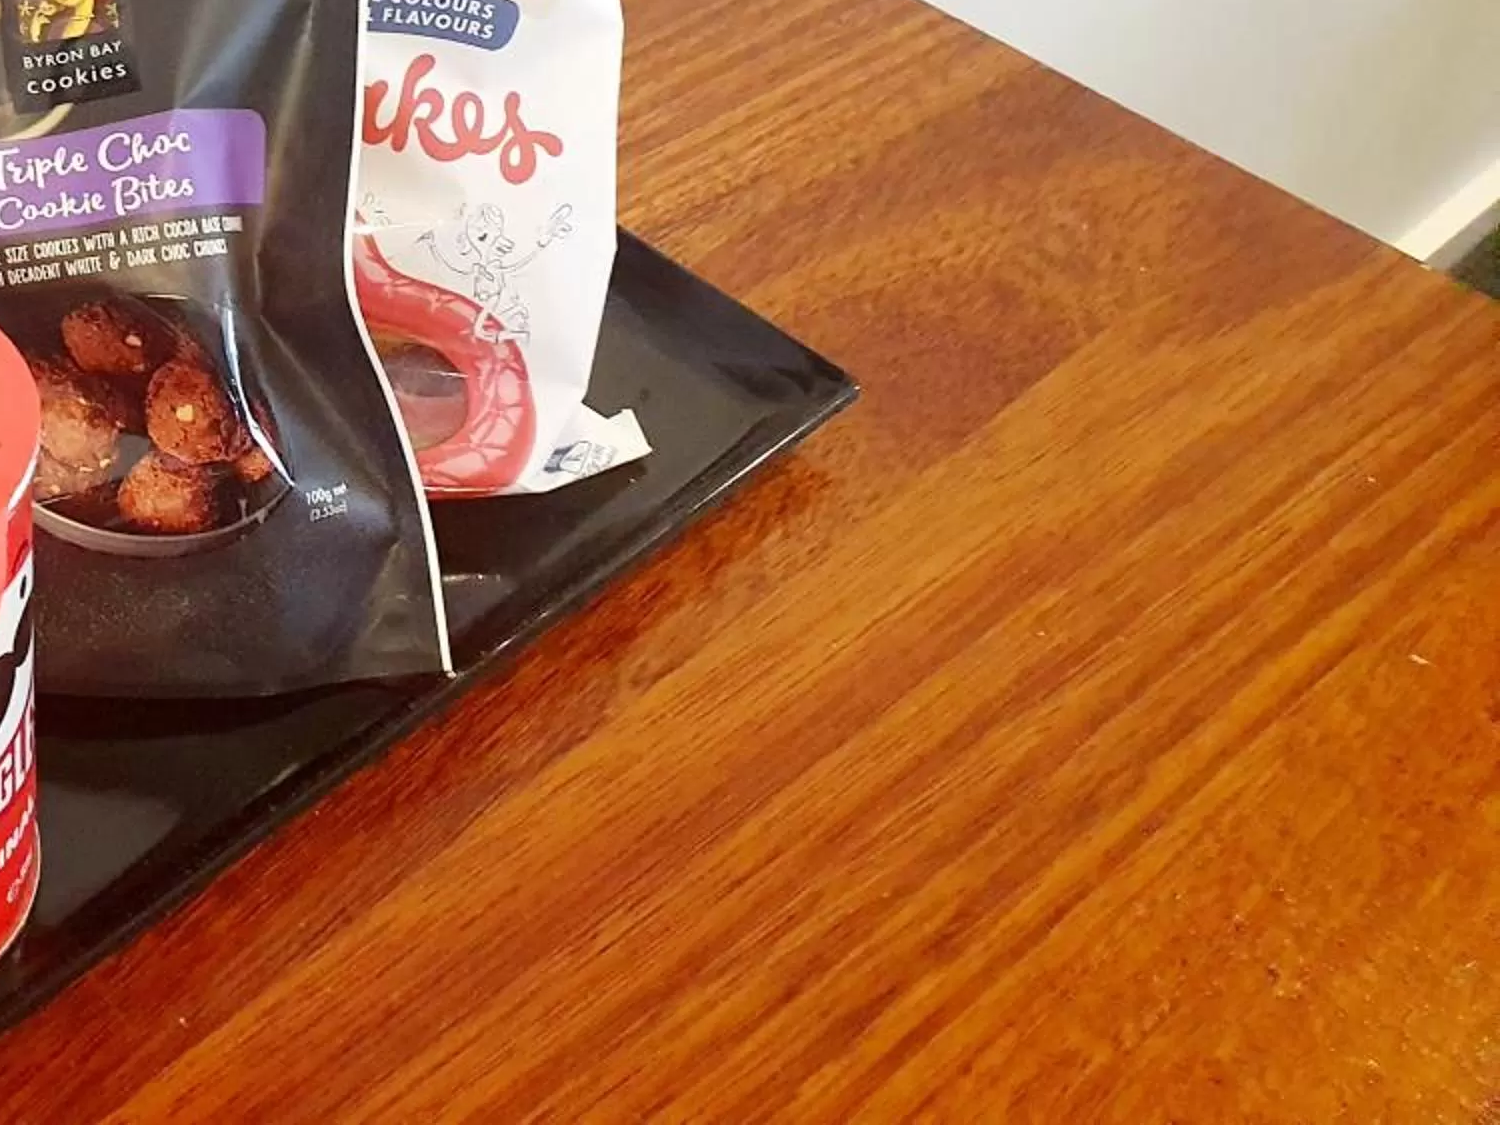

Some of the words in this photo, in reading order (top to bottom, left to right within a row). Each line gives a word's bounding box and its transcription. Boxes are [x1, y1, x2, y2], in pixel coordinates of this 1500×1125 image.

[383, 8, 494, 40] FLAVOURS
[22, 48, 84, 70] BYRON
[88, 40, 121, 58] BAY
[26, 63, 127, 94] cookies
[97, 132, 192, 172] Choc
[111, 174, 195, 216] Bites
[4, 245, 30, 264] SIZE
[33, 238, 80, 260] COOKIES
[83, 232, 115, 252] WITH
[119, 229, 128, 246] A
[131, 225, 161, 244] RICH
[163, 219, 199, 238] COCOA
[7, 262, 61, 286] DECADENT
[64, 255, 102, 277] WHITE
[108, 251, 121, 270] &
[126, 247, 157, 267] DARK
[161, 242, 191, 263] CHOC
